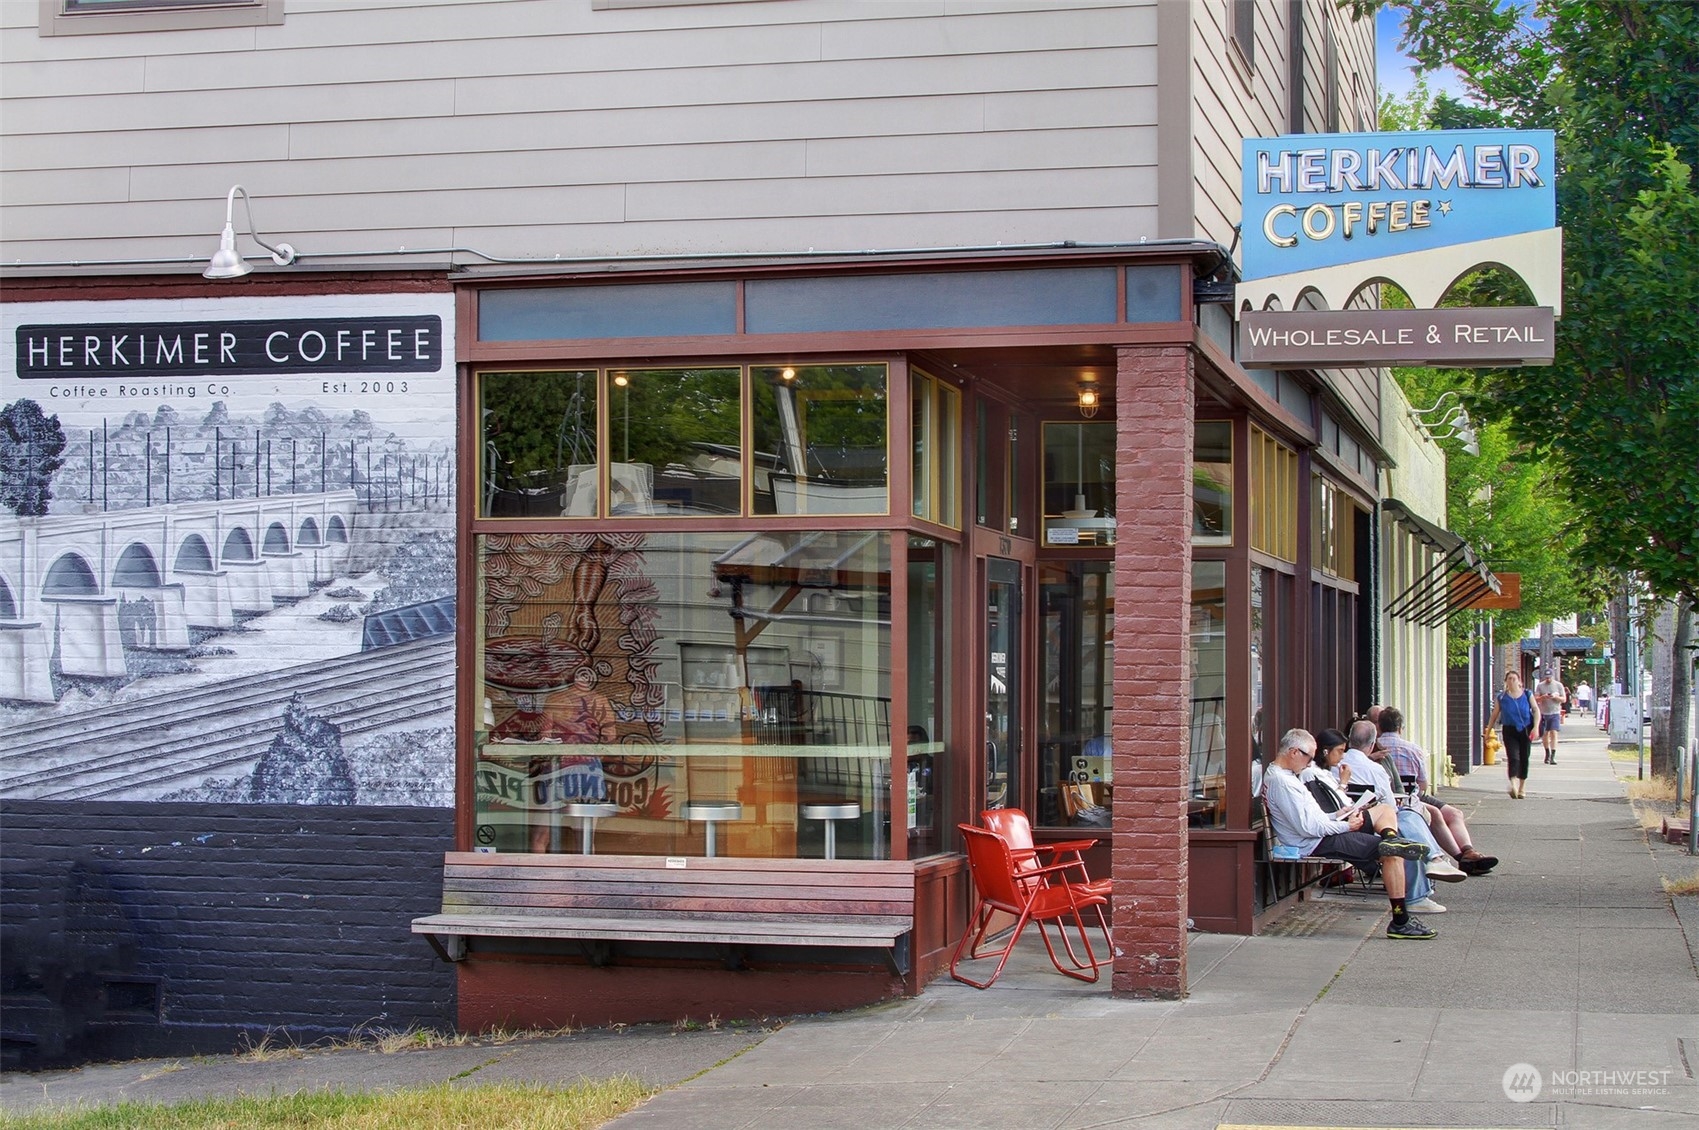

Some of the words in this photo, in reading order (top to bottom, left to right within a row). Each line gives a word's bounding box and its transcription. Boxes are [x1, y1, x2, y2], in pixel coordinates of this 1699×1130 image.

[1257, 144, 1546, 194] HERKIMER
[1263, 200, 1431, 247] COFFEE
[28, 333, 237, 367] HERKIMER
[265, 329, 430, 363] COFFEE
[1248, 326, 1414, 347] WHOLESALE
[1425, 324, 1442, 344] &
[1454, 324, 1545, 344] RETAIL
[50, 385, 108, 398] Coffee
[119, 384, 196, 397] Roasting
[207, 383, 237, 396] Co.
[322, 381, 353, 393] Est.
[360, 381, 409, 393] 2003
